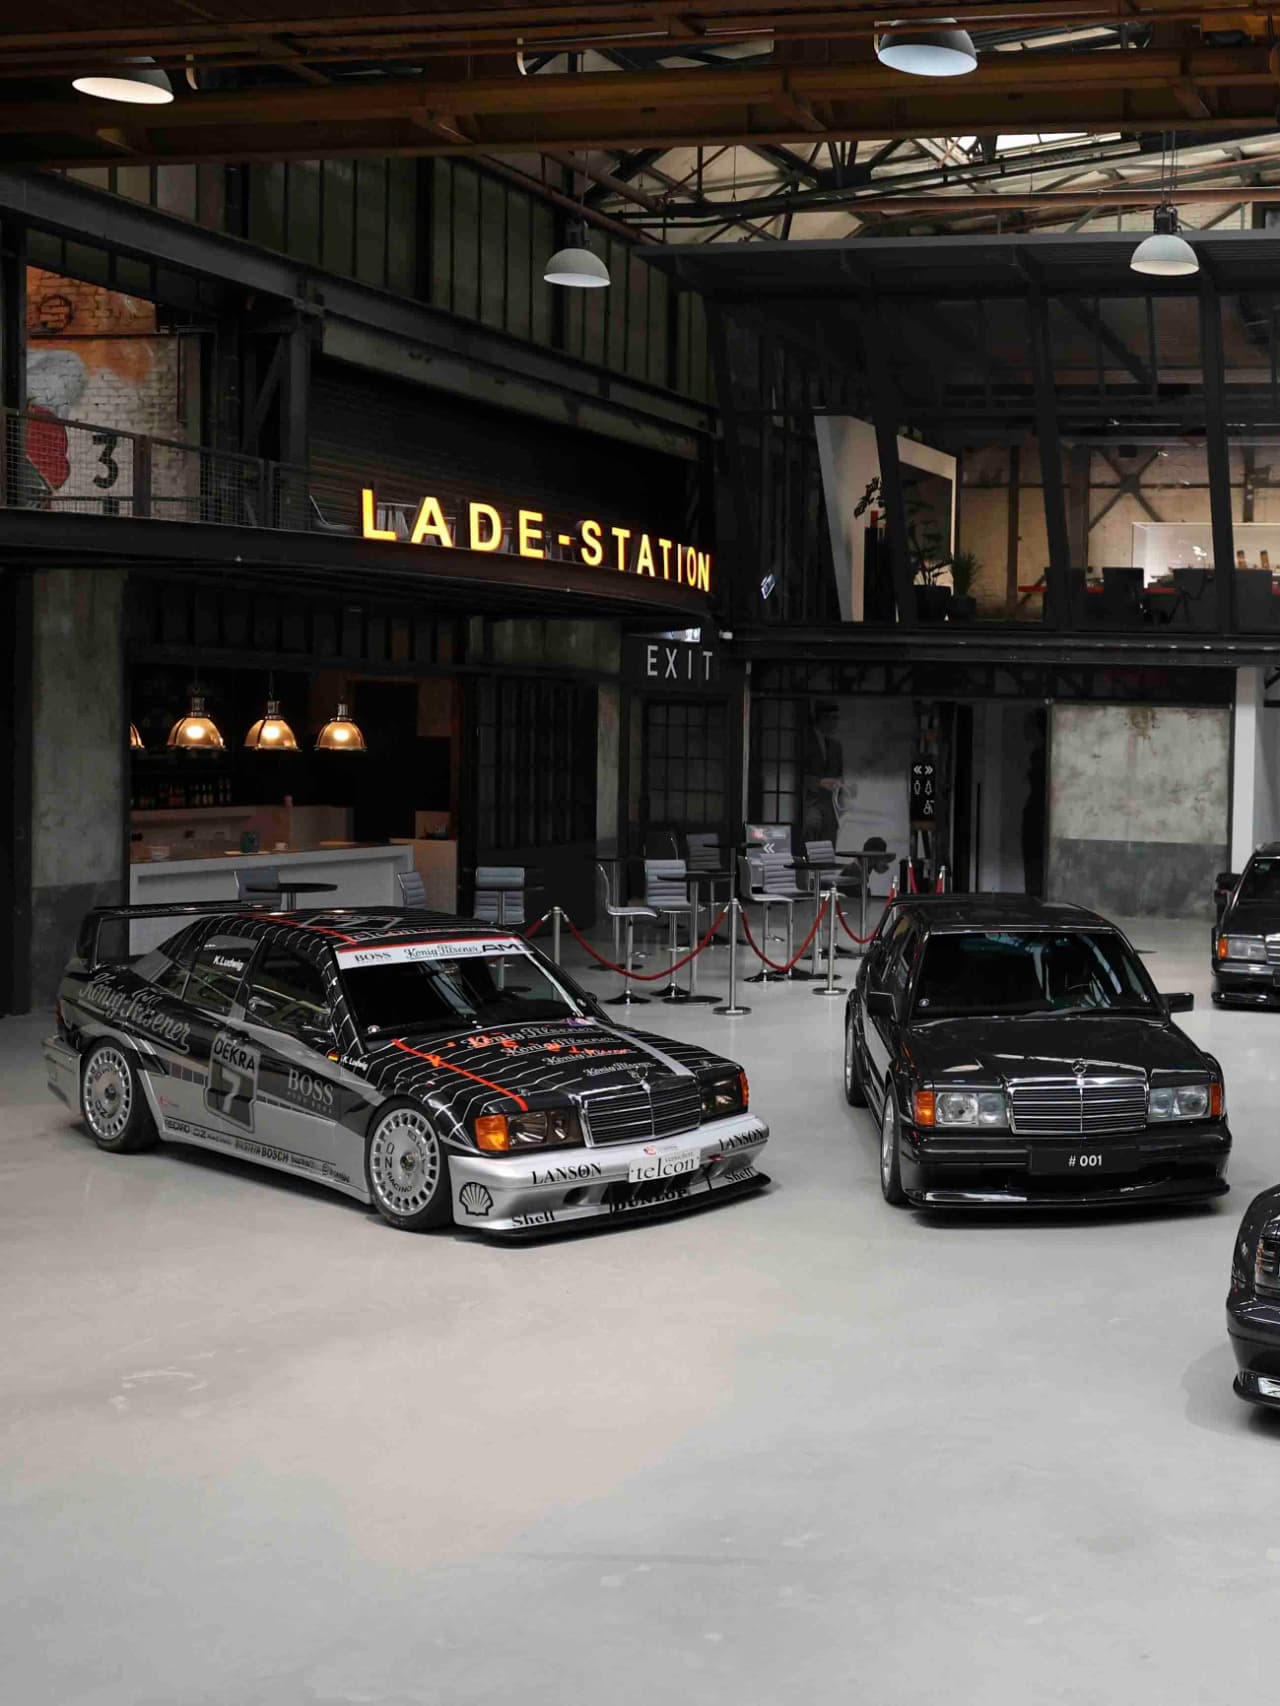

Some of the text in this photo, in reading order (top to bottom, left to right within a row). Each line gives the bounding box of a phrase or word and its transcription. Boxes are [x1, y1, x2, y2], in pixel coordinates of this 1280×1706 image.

[92, 433, 119, 490] 3
[361, 487, 712, 593] LADE-STATION
[647, 644, 714, 681] EXIT
[354, 952, 391, 963] BOSS
[214, 1040, 255, 1074] DEKRA
[222, 1068, 241, 1113] 7
[287, 1068, 334, 1106] BOSS
[719, 1129, 766, 1150] LANSON
[261, 1146, 290, 1163] BOSCH
[1068, 1154, 1102, 1167] # 001
[531, 1162, 602, 1185] LANSON
[636, 1157, 695, 1180] telcon
[724, 1166, 754, 1184] Shell
[511, 1211, 555, 1228] Shell
